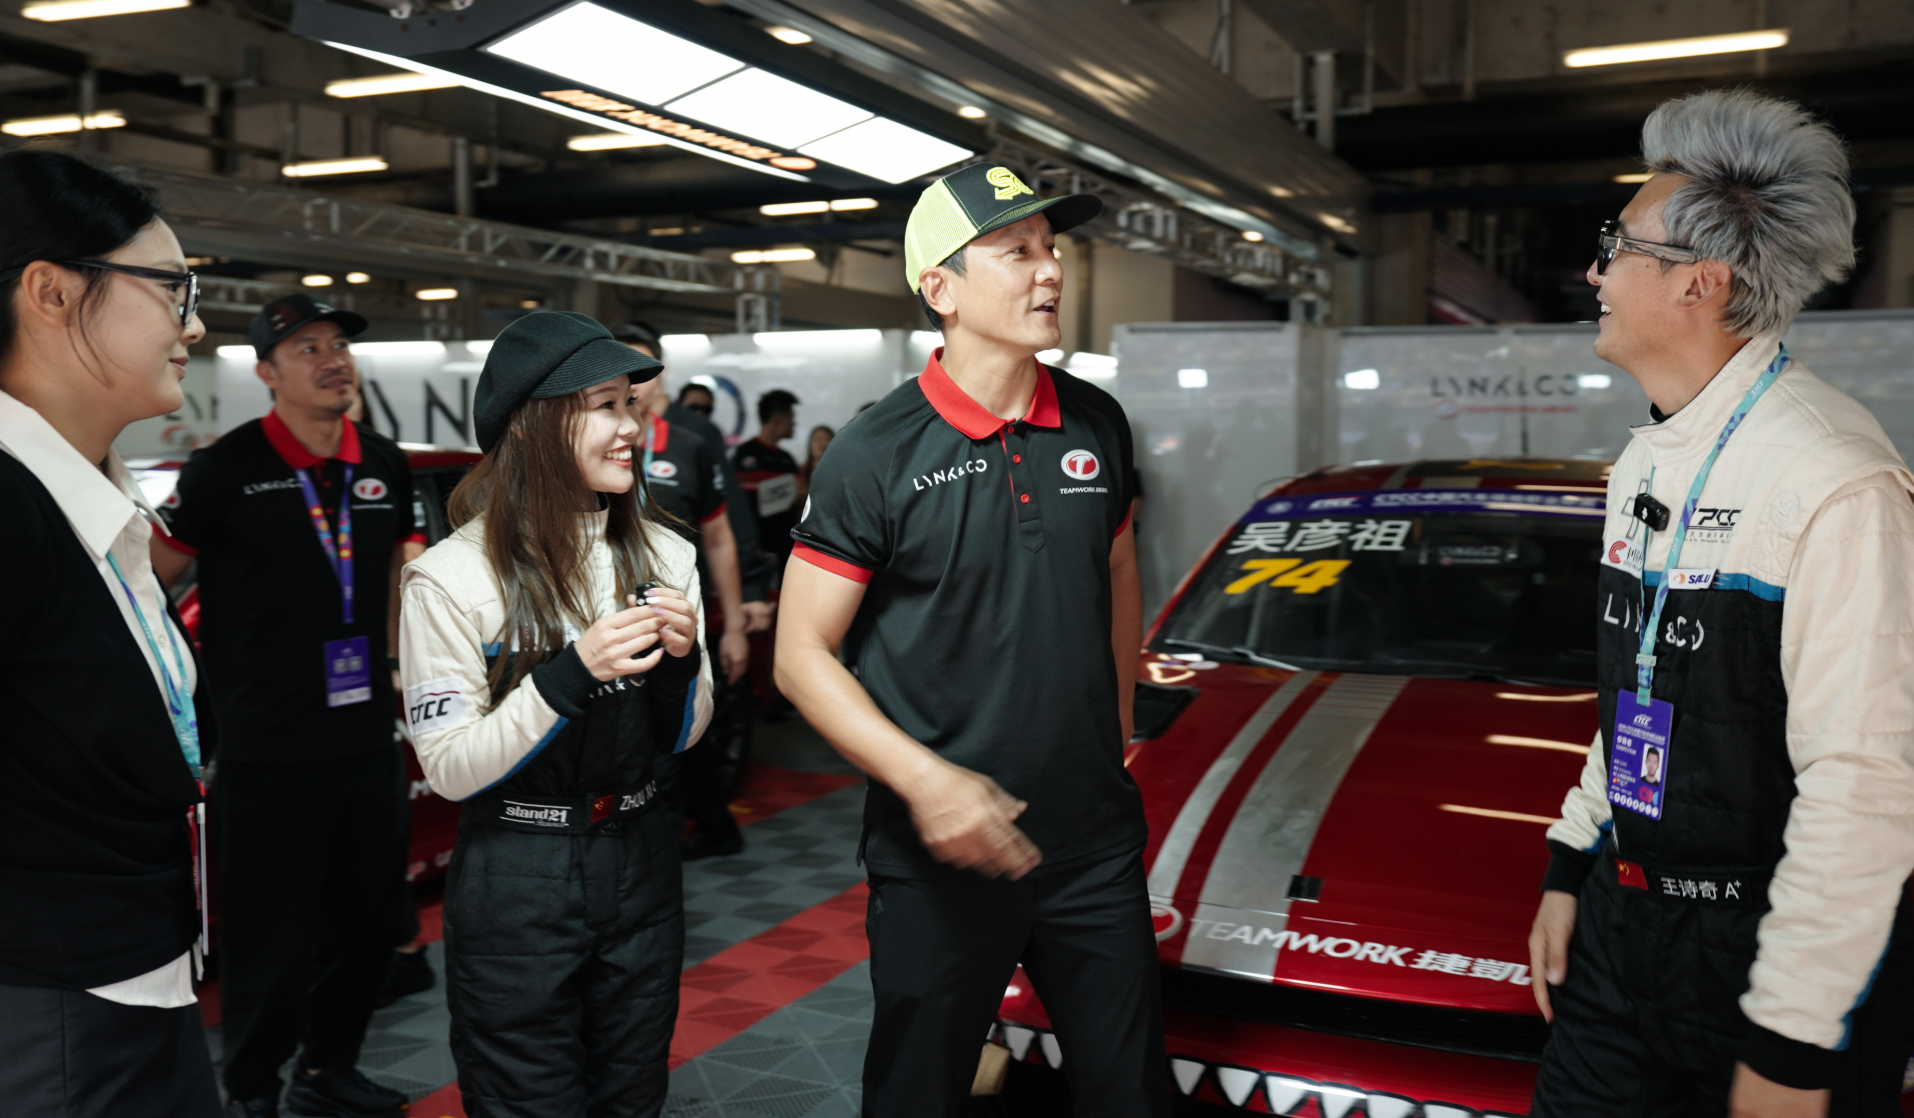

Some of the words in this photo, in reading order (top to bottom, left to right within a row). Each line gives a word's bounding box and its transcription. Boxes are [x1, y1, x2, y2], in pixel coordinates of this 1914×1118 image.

[1059, 486, 1096, 494] TEAMWORK
[1226, 518, 1413, 554] 吴彦祖
[1224, 558, 1353, 594] 74
[1189, 917, 1414, 967] TEAMWORK
